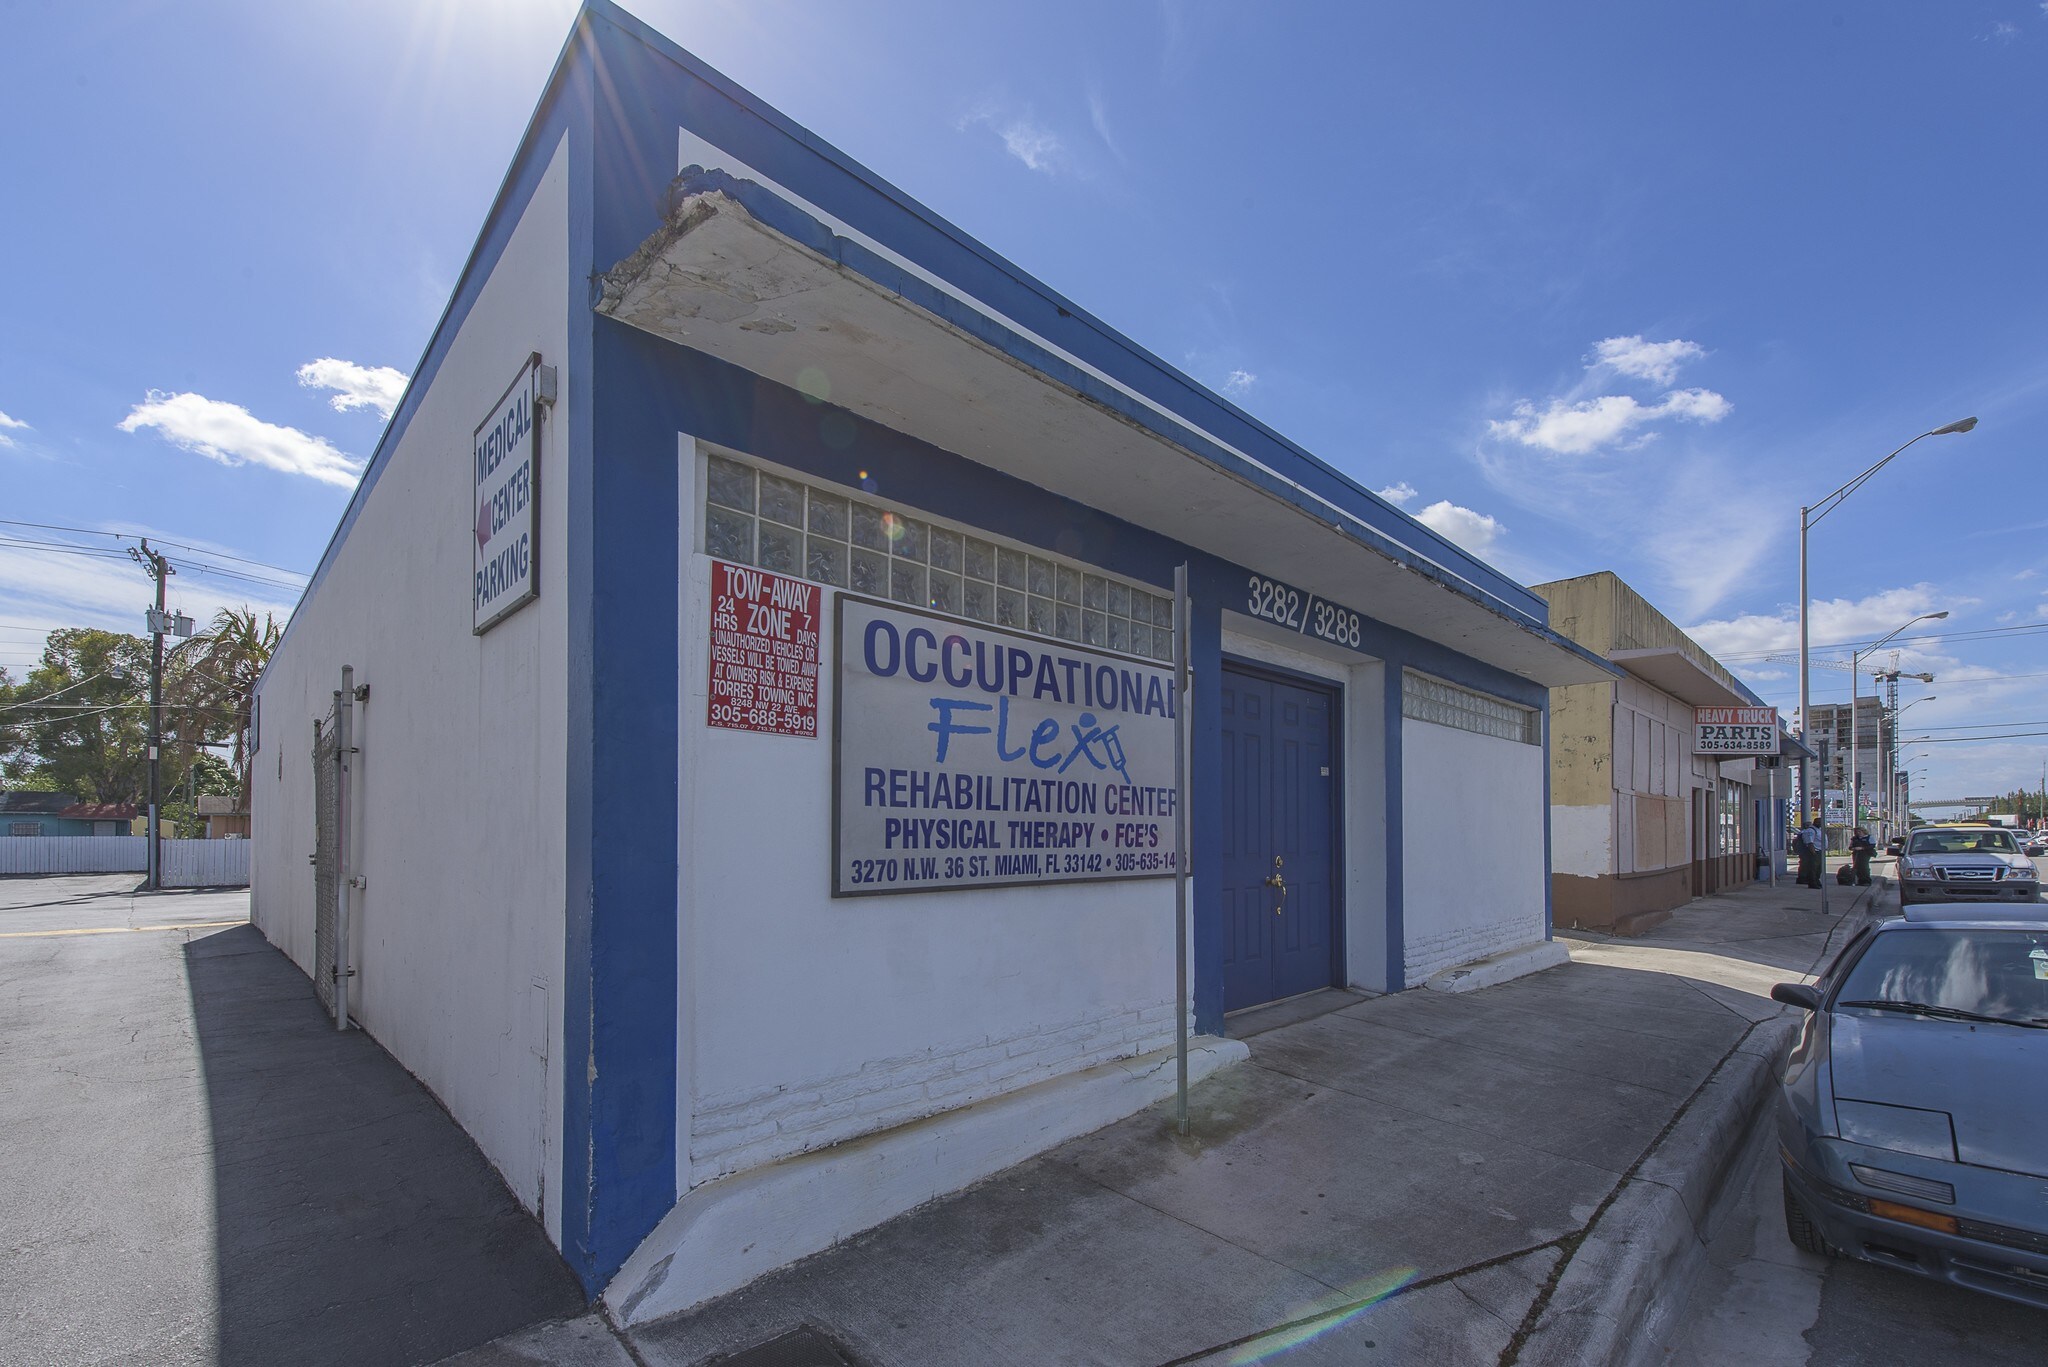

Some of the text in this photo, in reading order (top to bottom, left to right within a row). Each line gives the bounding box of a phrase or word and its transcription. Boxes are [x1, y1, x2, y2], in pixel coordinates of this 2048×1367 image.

[477, 388, 531, 486] MEDICAL
[491, 459, 530, 535] CENTER
[476, 532, 529, 610] PARKING
[718, 595, 735, 614] 24
[723, 565, 812, 613] TOW-AWAY
[714, 612, 738, 631] HRS
[747, 602, 791, 640] ZONE
[803, 614, 812, 630] 7
[715, 629, 815, 662] UNAUTHORIZED VEHICLES OR
[796, 629, 817, 647] DAYS
[711, 645, 818, 678] VESSELS WILL BE TOWED AWAY
[863, 619, 1176, 719] OCCUPATIONAL
[713, 679, 816, 708] TORRES TOWING INC.
[714, 663, 814, 693] AT OWNERS RISK & EXPENSE
[711, 703, 815, 731] 305-688-5919
[730, 697, 800, 715] 8248 NW 22 AVE.
[1697, 708, 1773, 723] HEAVY TRUCK
[927, 695, 1107, 775] Flex
[1700, 725, 1772, 740] PARTS
[1700, 740, 1772, 750] 305-634-8589
[864, 767, 1176, 817] REHABILITATION CENTER
[885, 817, 1159, 849] PHYSICAL THERAPY FCE'S
[851, 851, 1187, 884] 3270 N.W. 36 ST. MIAMI, FL 33142 305-635-14
